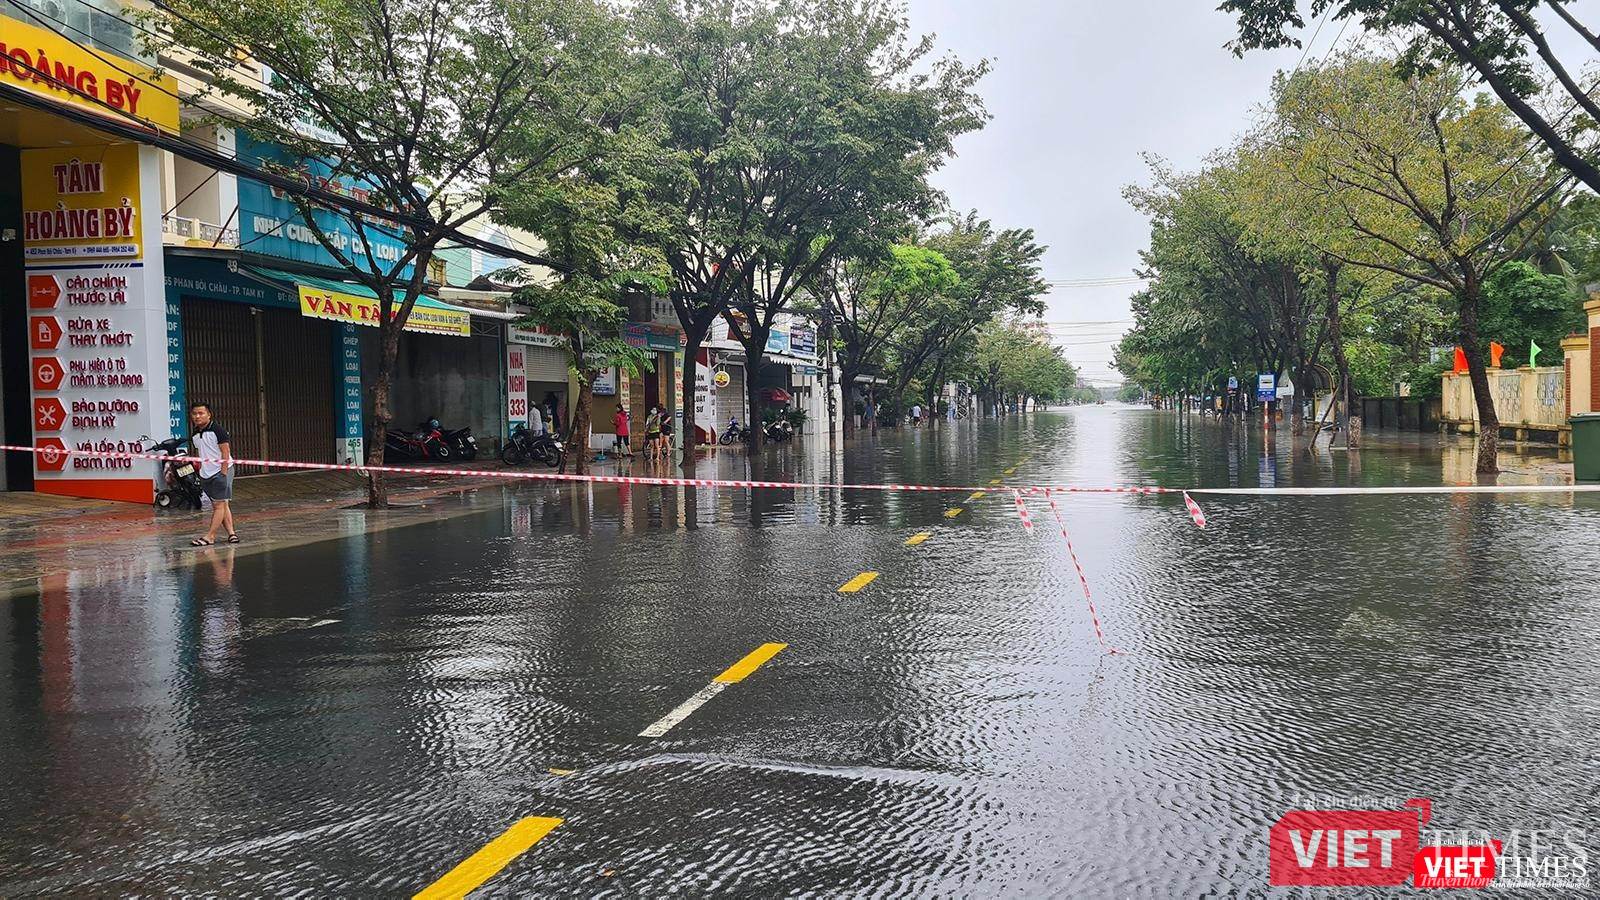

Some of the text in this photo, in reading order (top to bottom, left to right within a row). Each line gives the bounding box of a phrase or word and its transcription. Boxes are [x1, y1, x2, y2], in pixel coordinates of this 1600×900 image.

[54, 157, 104, 194] TÂN
[25, 197, 136, 241] HOÀNG BỶ
[254, 215, 283, 239] NHÀ
[66, 273, 126, 290] CÂN CHỈNH
[173, 277, 194, 288] PHAN
[208, 281, 228, 294] CHÂU
[243, 288, 256, 297] TAM
[67, 288, 126, 304] THƯỚC LÁI
[304, 295, 353, 319] VĂN
[68, 317, 110, 331] RỬA XE
[167, 322, 178, 331] DF
[69, 331, 133, 346] THAY NHỚT
[70, 358, 126, 374] PHỤ KIỆN Ô TÔ
[509, 348, 524, 369] NHÀ
[97, 374, 106, 386] XE
[120, 374, 144, 388] DẠNG
[72, 398, 139, 412] BẢO DƯỠNG
[509, 400, 526, 416] 333
[72, 414, 116, 431] ĐỊNH KỲ
[76, 438, 142, 454] VÁ LỐP Ô TÔ
[74, 458, 103, 469] BƠM
